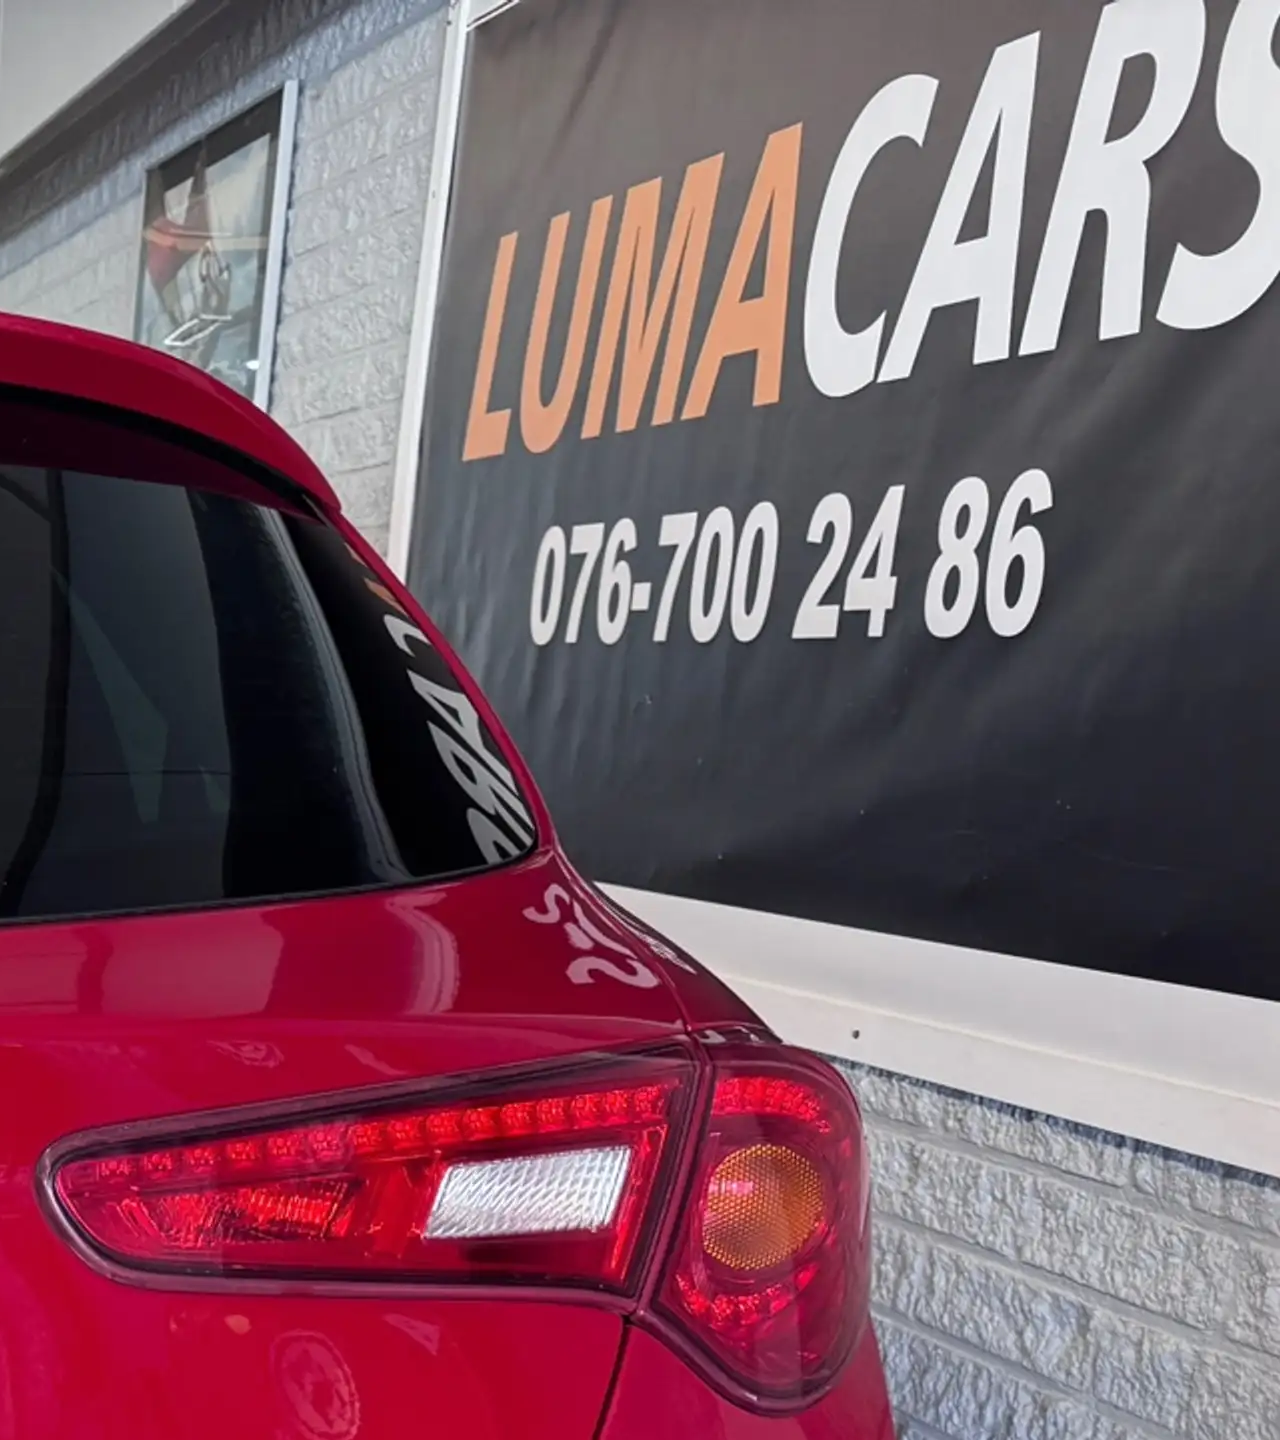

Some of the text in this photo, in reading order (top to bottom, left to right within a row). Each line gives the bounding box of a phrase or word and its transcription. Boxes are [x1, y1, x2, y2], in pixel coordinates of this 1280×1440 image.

[529, 468, 1053, 646] 076-700 24 86
